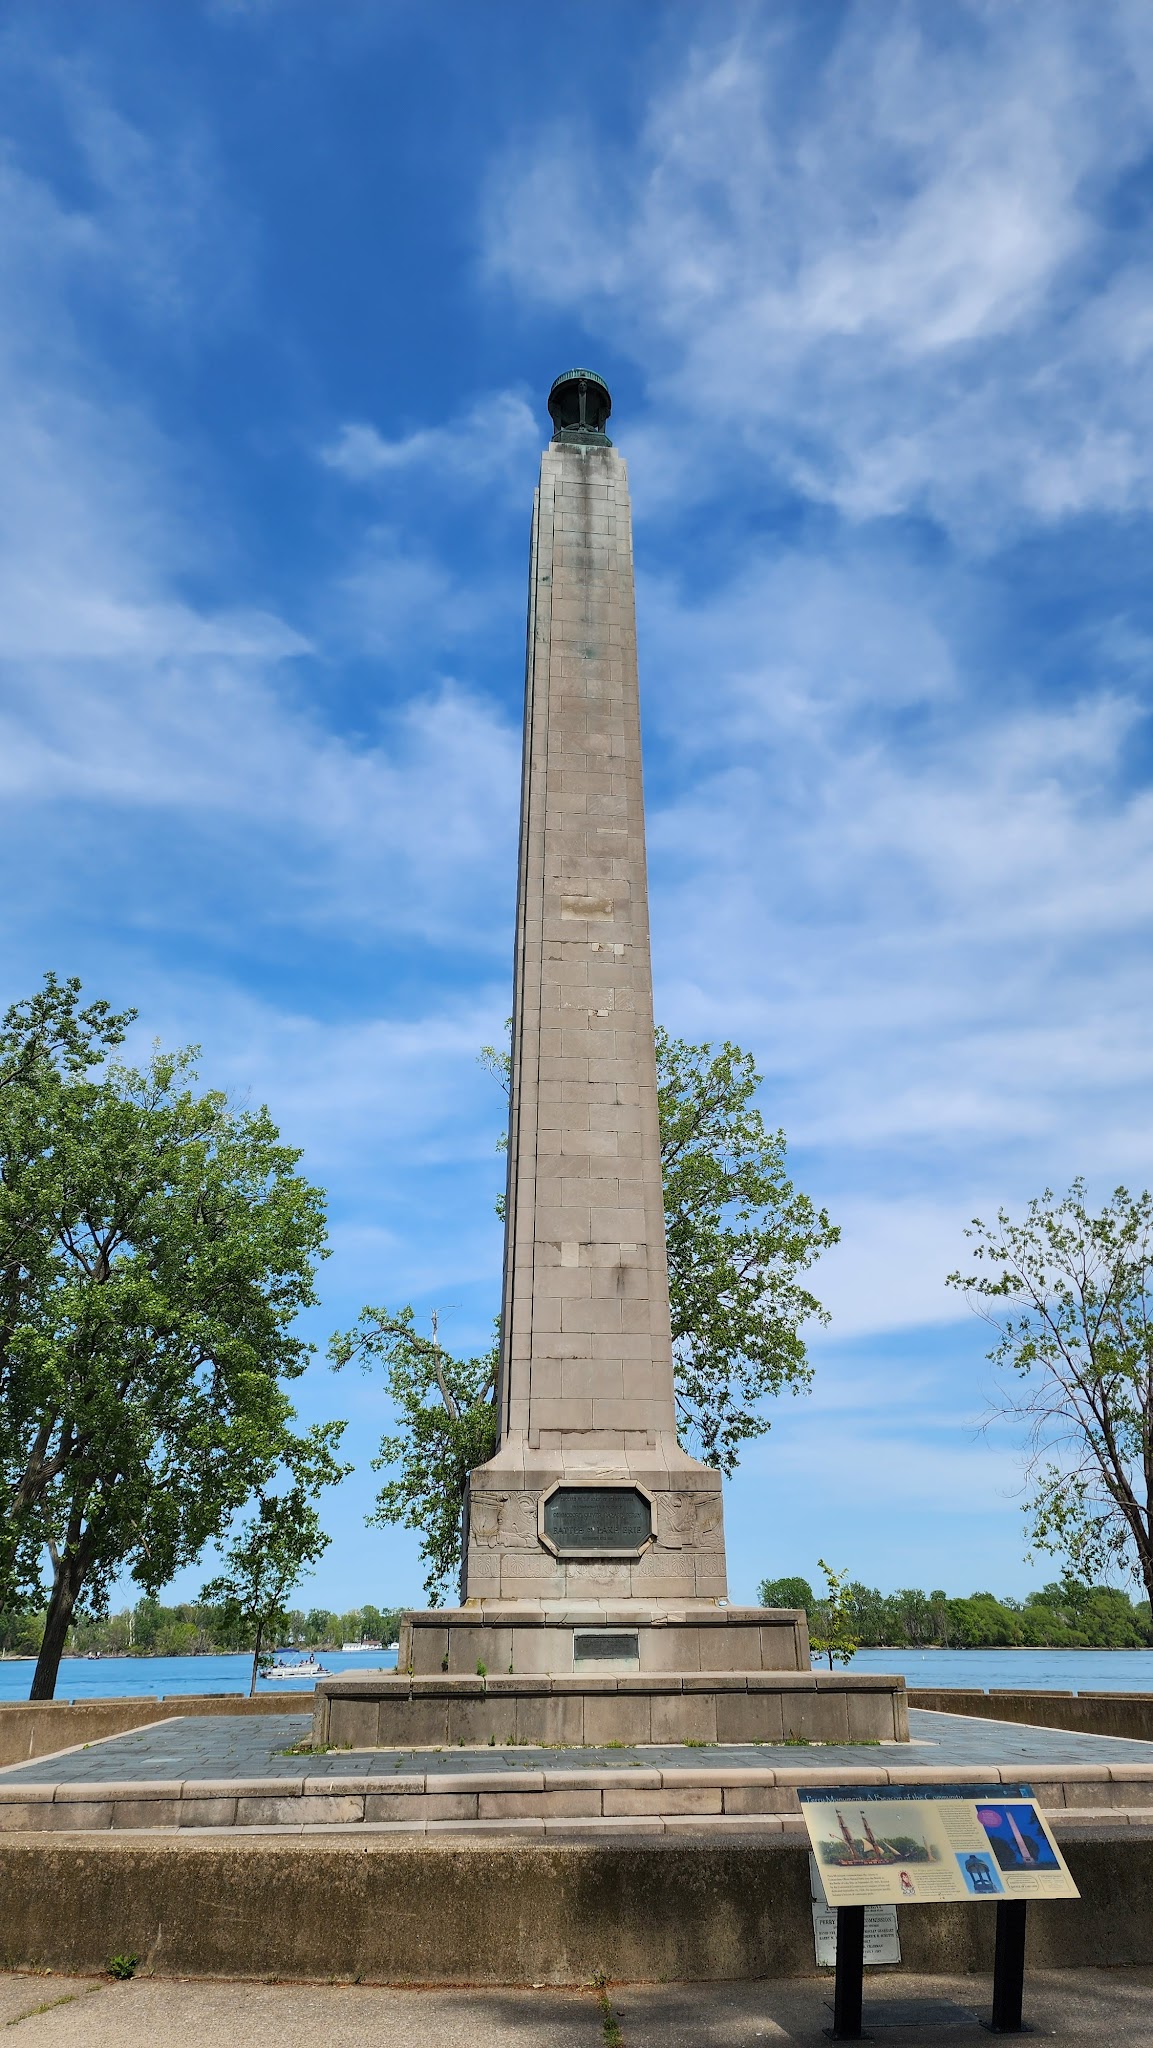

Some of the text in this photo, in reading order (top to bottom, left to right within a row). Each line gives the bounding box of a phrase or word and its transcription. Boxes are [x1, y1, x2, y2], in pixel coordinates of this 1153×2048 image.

[553, 1526, 584, 1535] BATTLE
[597, 1526, 619, 1534] LAKE
[623, 1526, 642, 1534] ERIE
[806, 1795, 825, 1804] Perry
[874, 1793, 903, 1802] Beacon
[912, 1793, 923, 1801] the
[925, 1793, 964, 1801] Community
